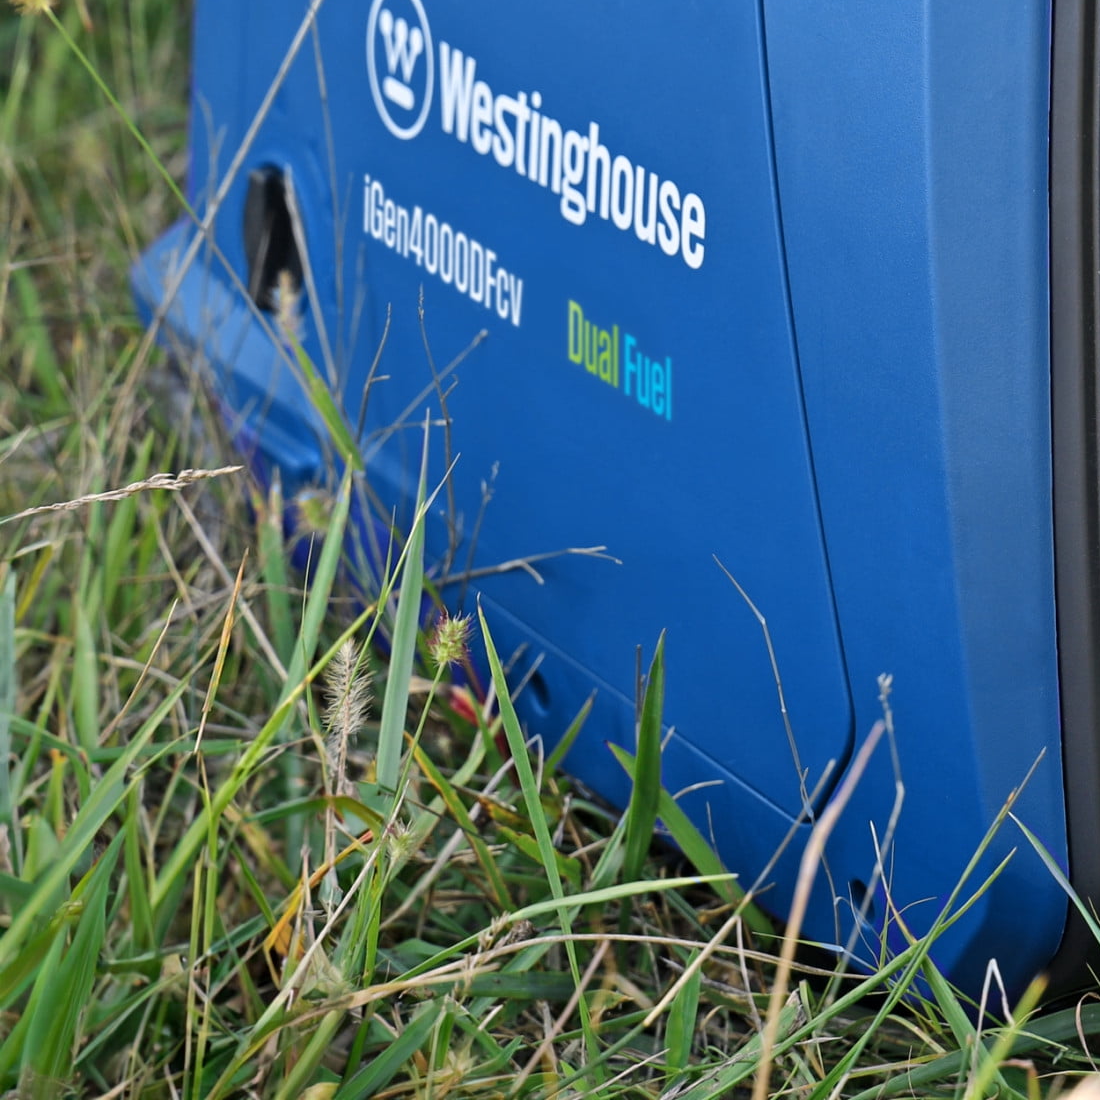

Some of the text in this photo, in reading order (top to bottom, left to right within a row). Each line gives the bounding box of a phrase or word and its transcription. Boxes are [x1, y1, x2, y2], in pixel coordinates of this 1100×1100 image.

[438, 40, 706, 270] Westinghouse
[568, 298, 672, 421] Dual Fuel
